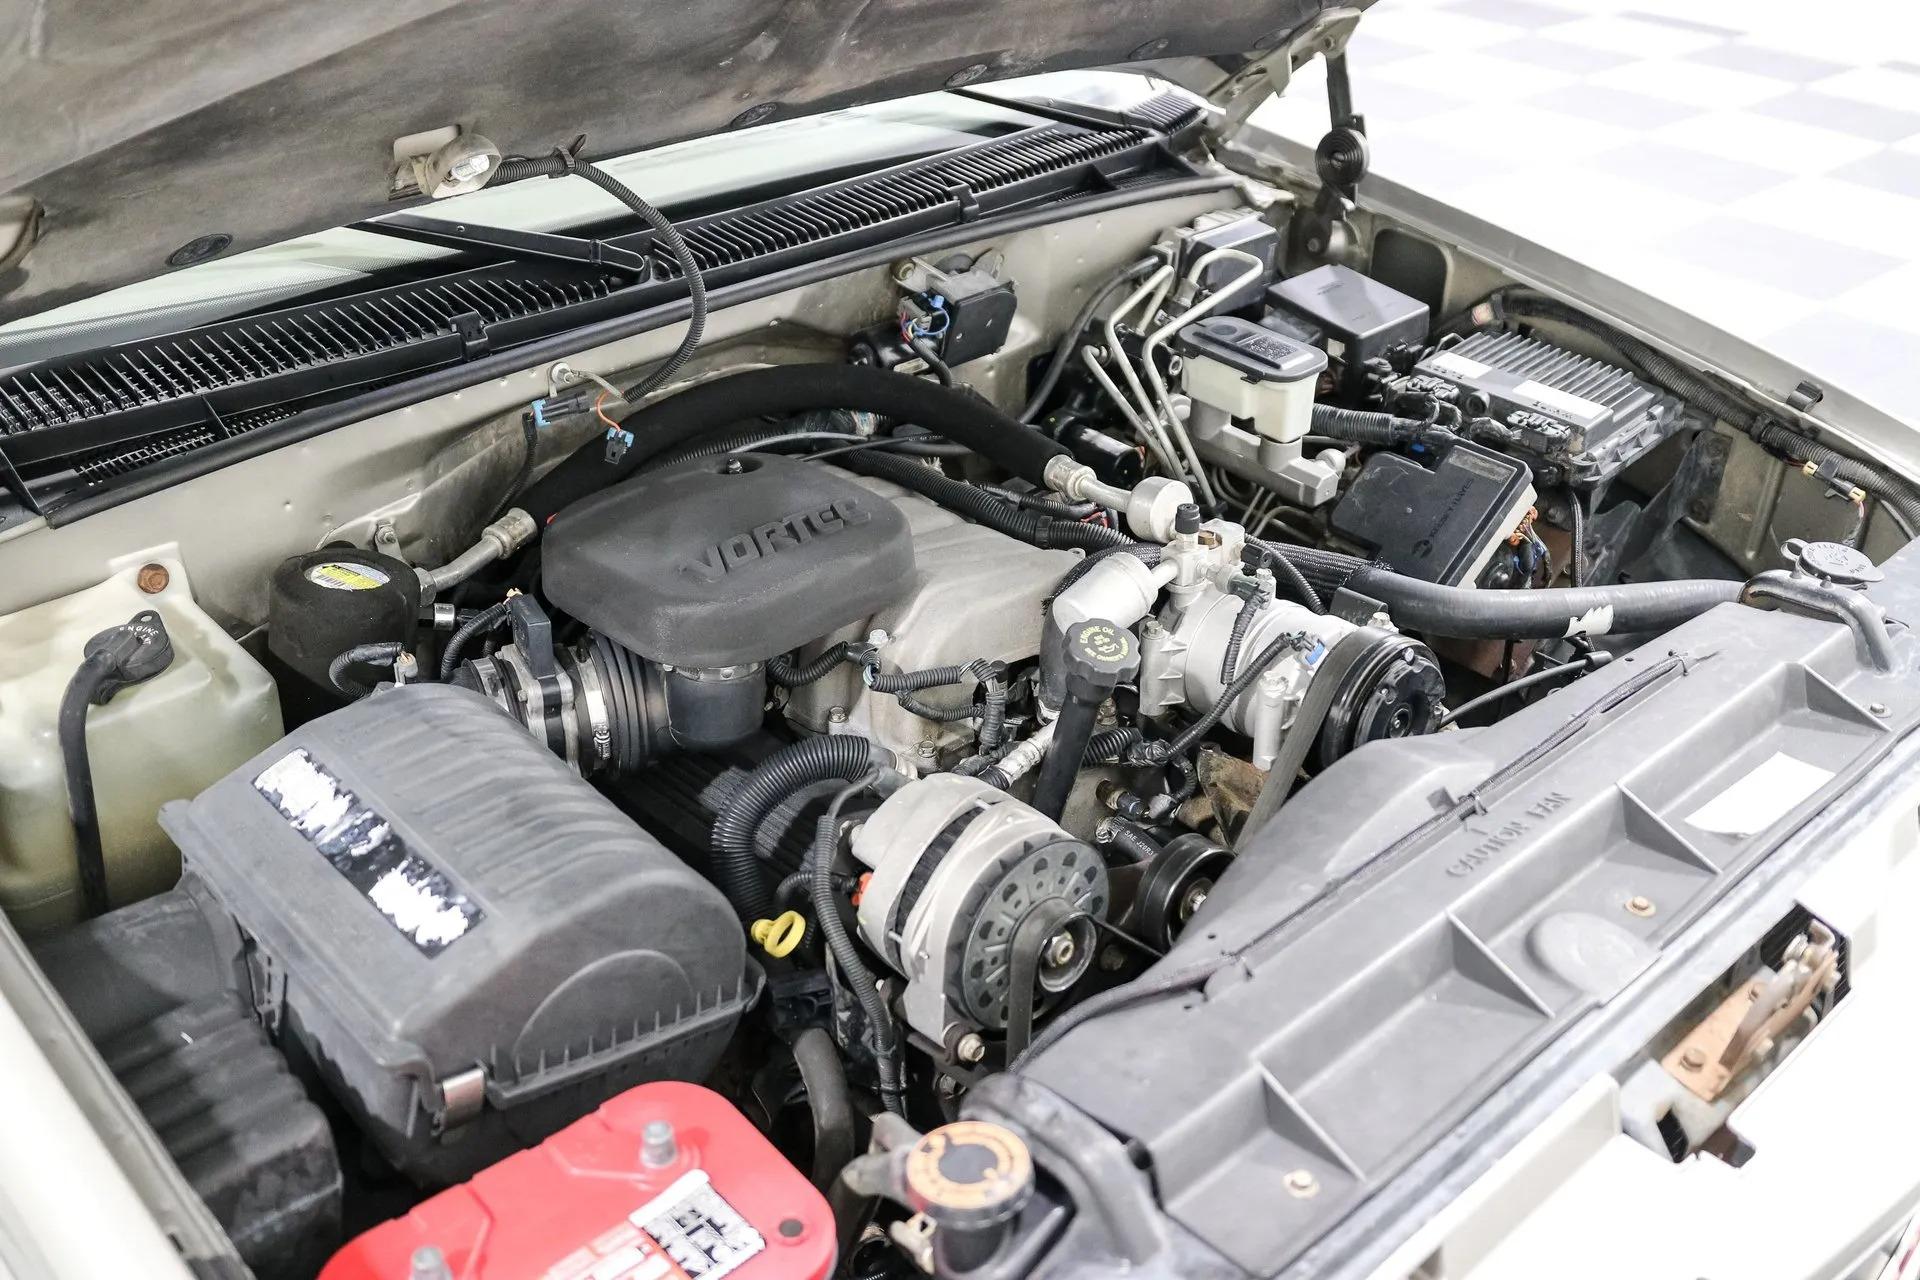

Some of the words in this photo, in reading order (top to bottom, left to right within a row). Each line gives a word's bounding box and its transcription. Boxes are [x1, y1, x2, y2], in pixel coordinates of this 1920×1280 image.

[678, 498, 872, 583] VORTEC
[1080, 625, 1101, 643] ENGINE
[1101, 626, 1115, 636] OIL
[1124, 830, 1138, 842] SAE
[1445, 820, 1530, 878] CAUTION
[1525, 791, 1572, 819] FAN
